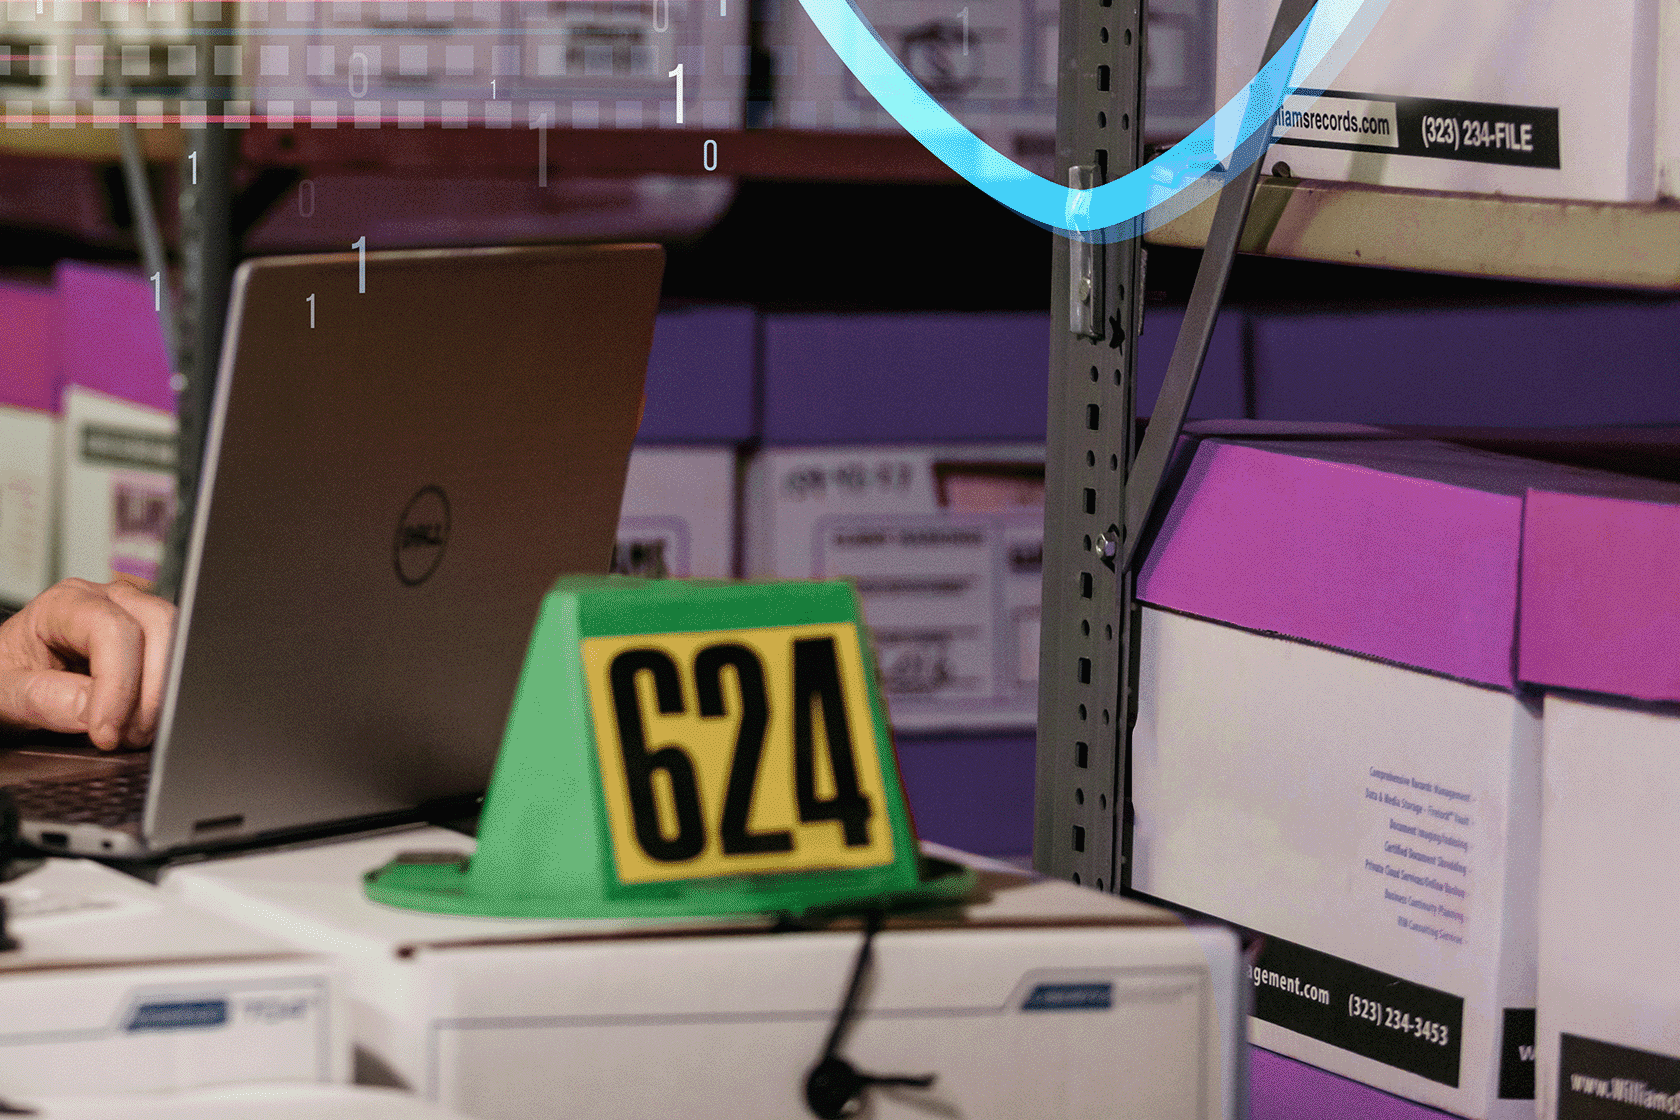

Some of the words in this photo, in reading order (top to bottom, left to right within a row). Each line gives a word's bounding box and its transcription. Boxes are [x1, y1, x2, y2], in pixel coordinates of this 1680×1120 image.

[1421, 115, 1460, 151] (323)
[1463, 120, 1534, 153] 234-FILE
[608, 634, 874, 865] 624
[1349, 993, 1383, 1026] (323)
[1384, 1007, 1450, 1046] 234-3453
